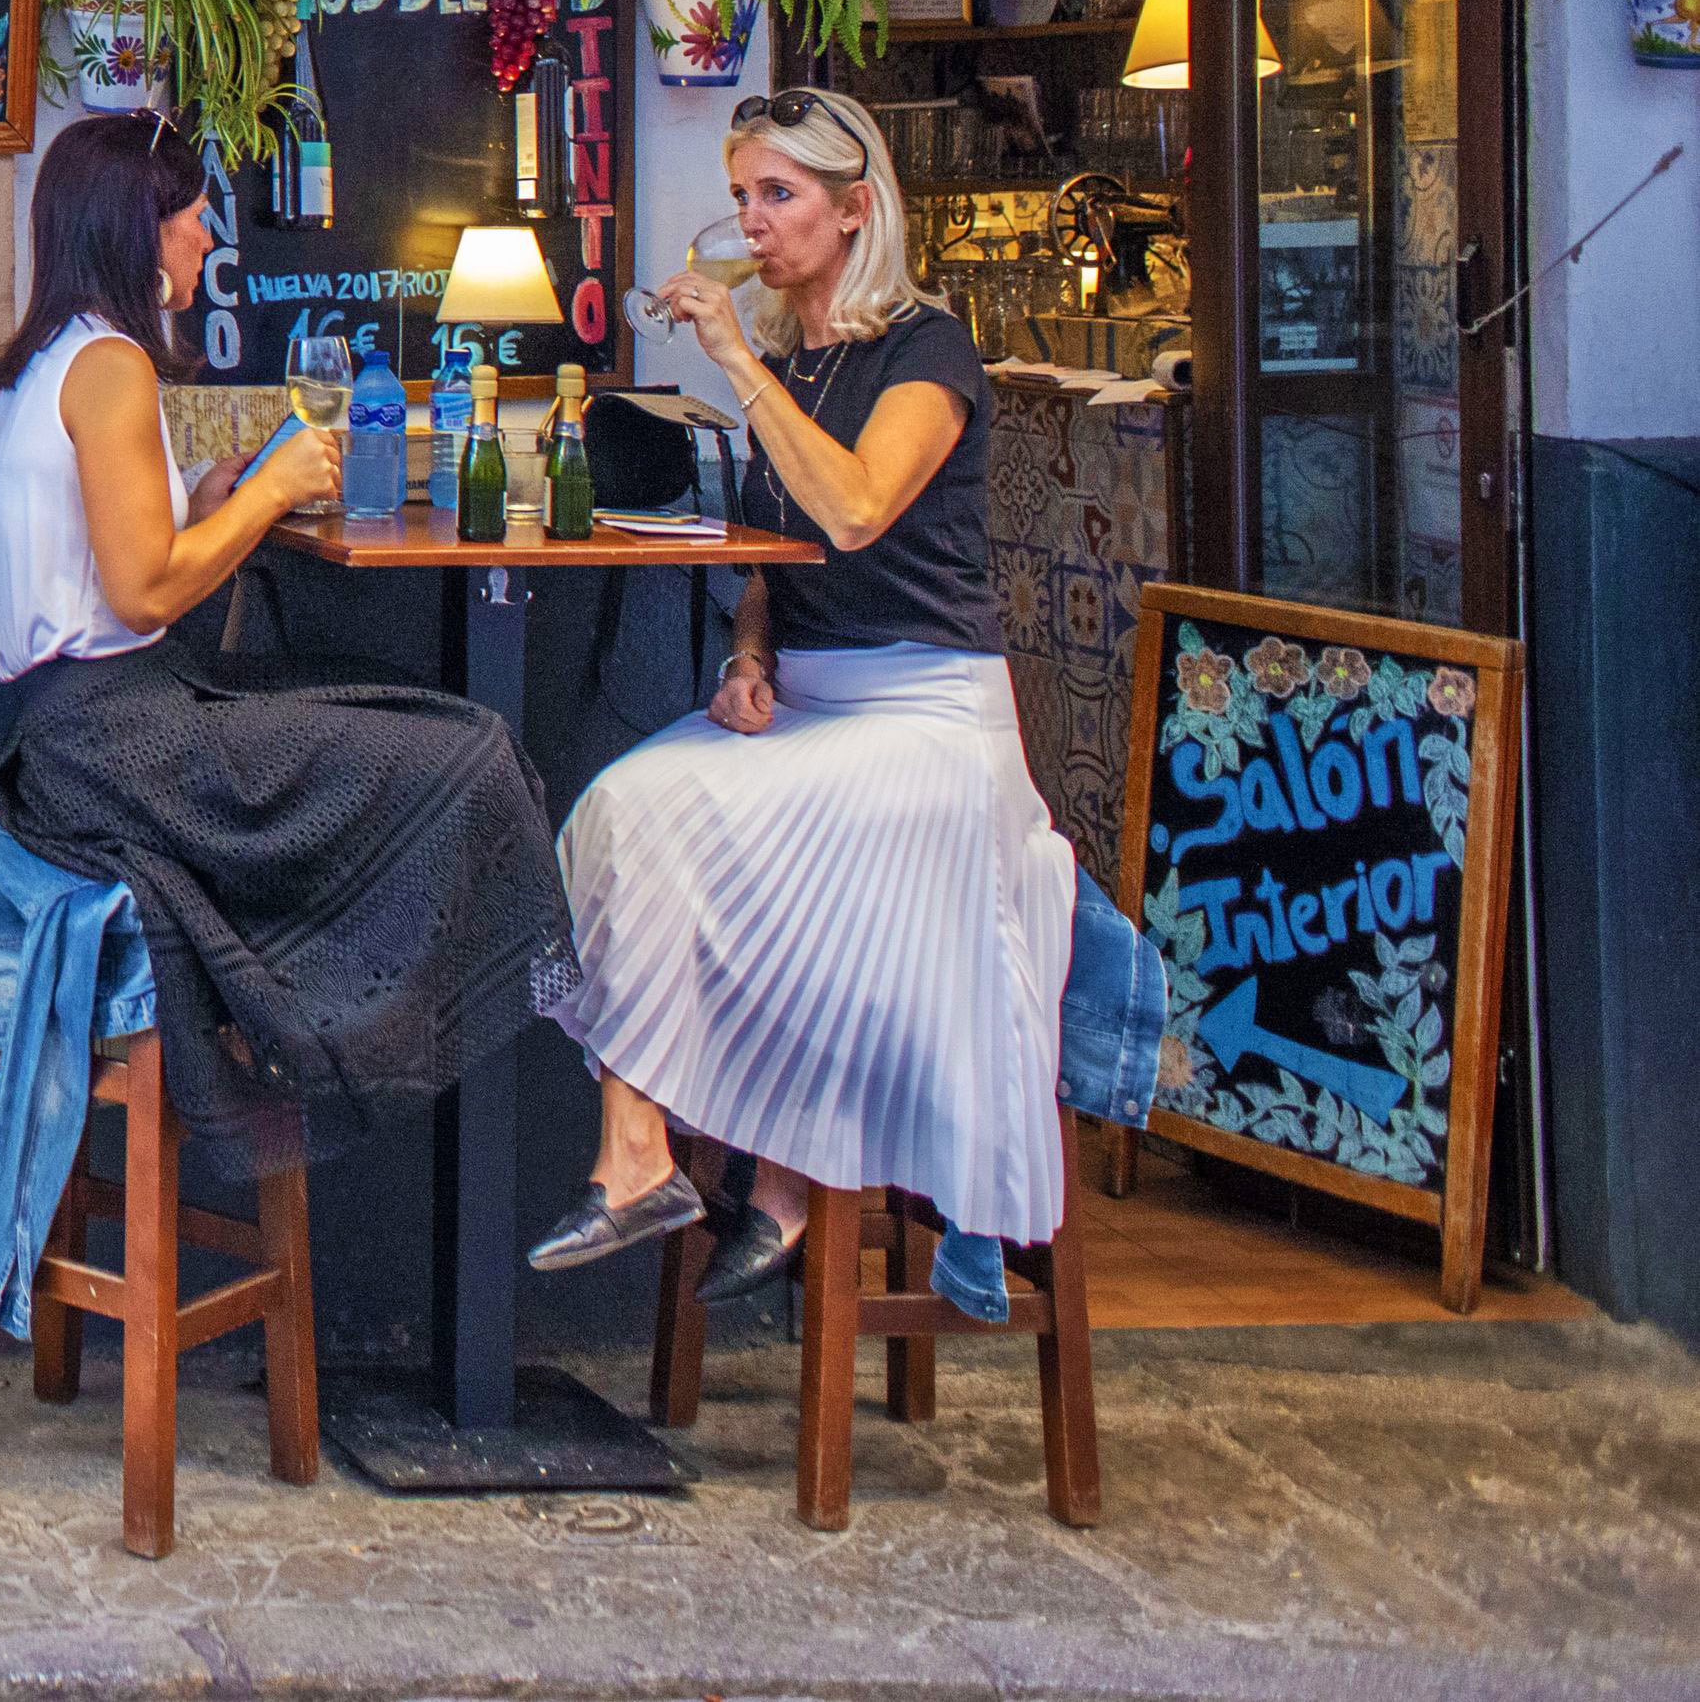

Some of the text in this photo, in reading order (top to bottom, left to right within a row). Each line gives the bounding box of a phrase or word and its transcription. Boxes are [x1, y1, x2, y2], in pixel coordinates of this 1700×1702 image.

[567, 16, 614, 345] TINTO
[248, 270, 401, 304] HUELVA 2017
[1170, 713, 1423, 866] Salón
[1180, 852, 1453, 975] Interior
